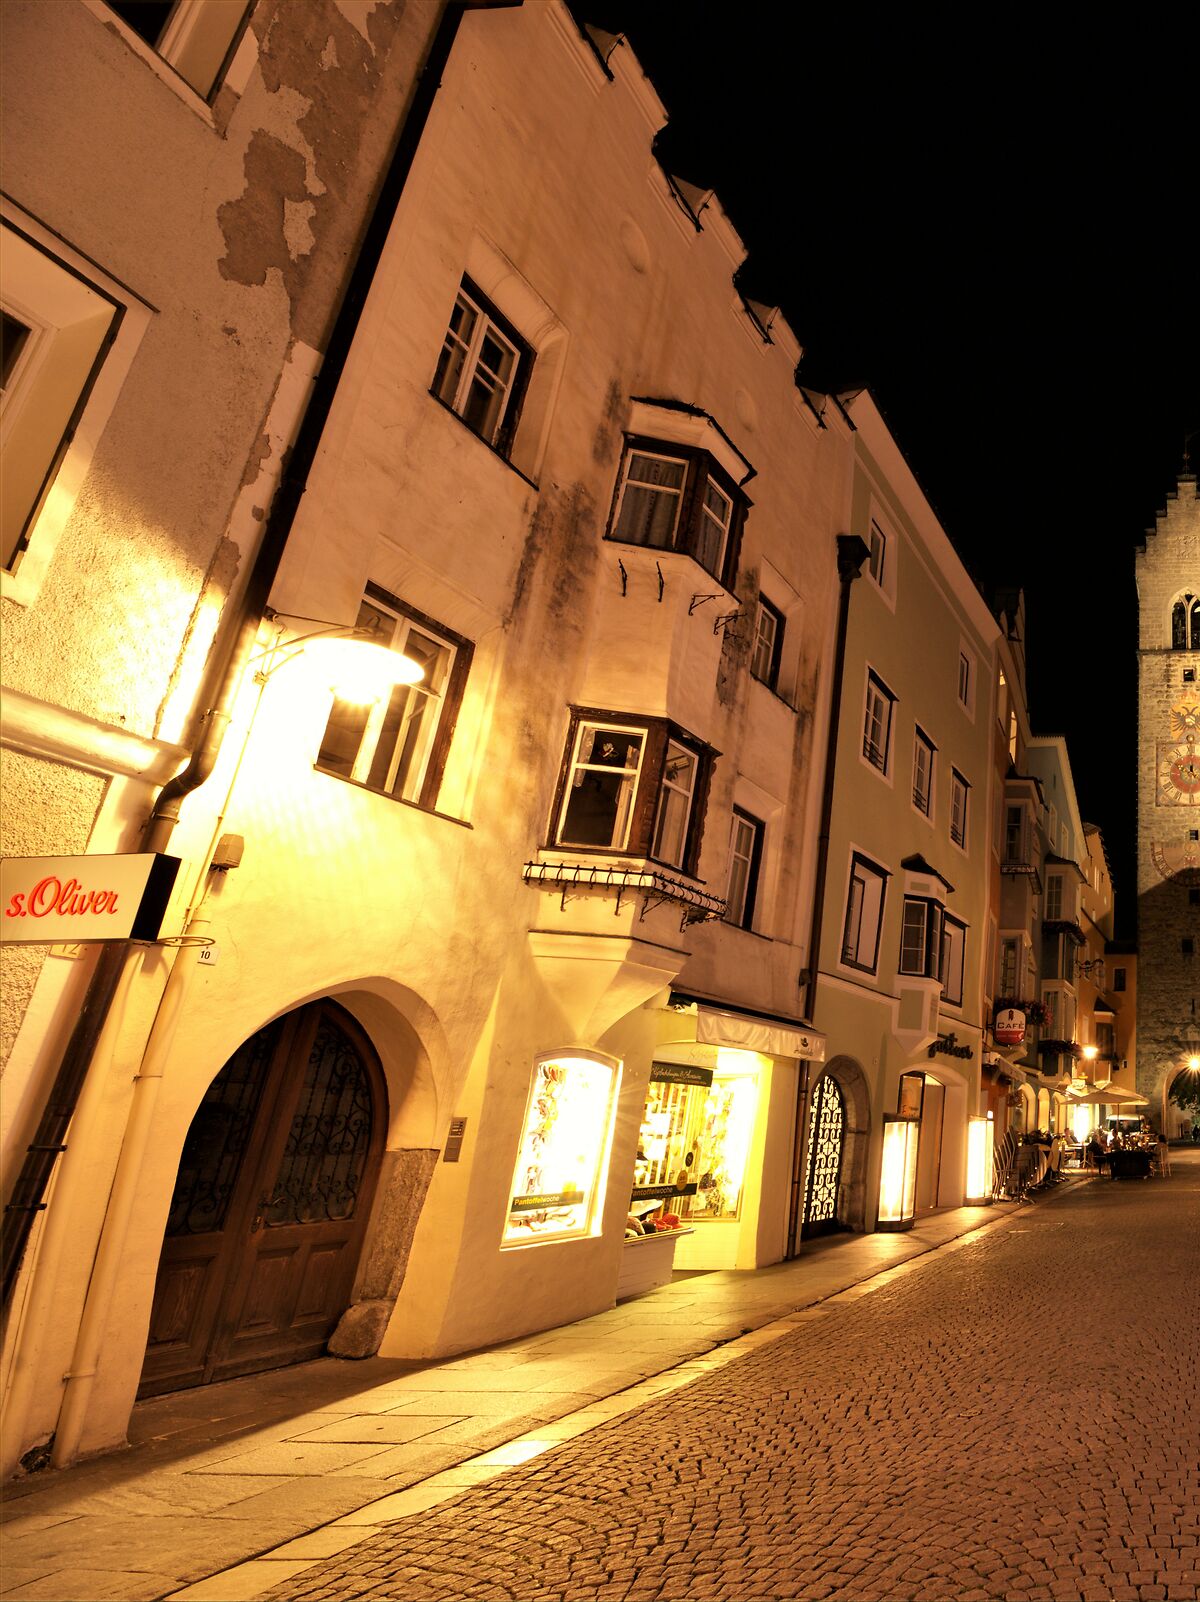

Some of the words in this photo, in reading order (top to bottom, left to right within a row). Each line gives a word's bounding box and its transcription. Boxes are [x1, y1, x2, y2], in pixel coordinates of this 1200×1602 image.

[5, 876, 119, 918] s.Oliver
[200, 949, 211, 961] 10
[514, 1196, 560, 1206] Pantoffelwoche
